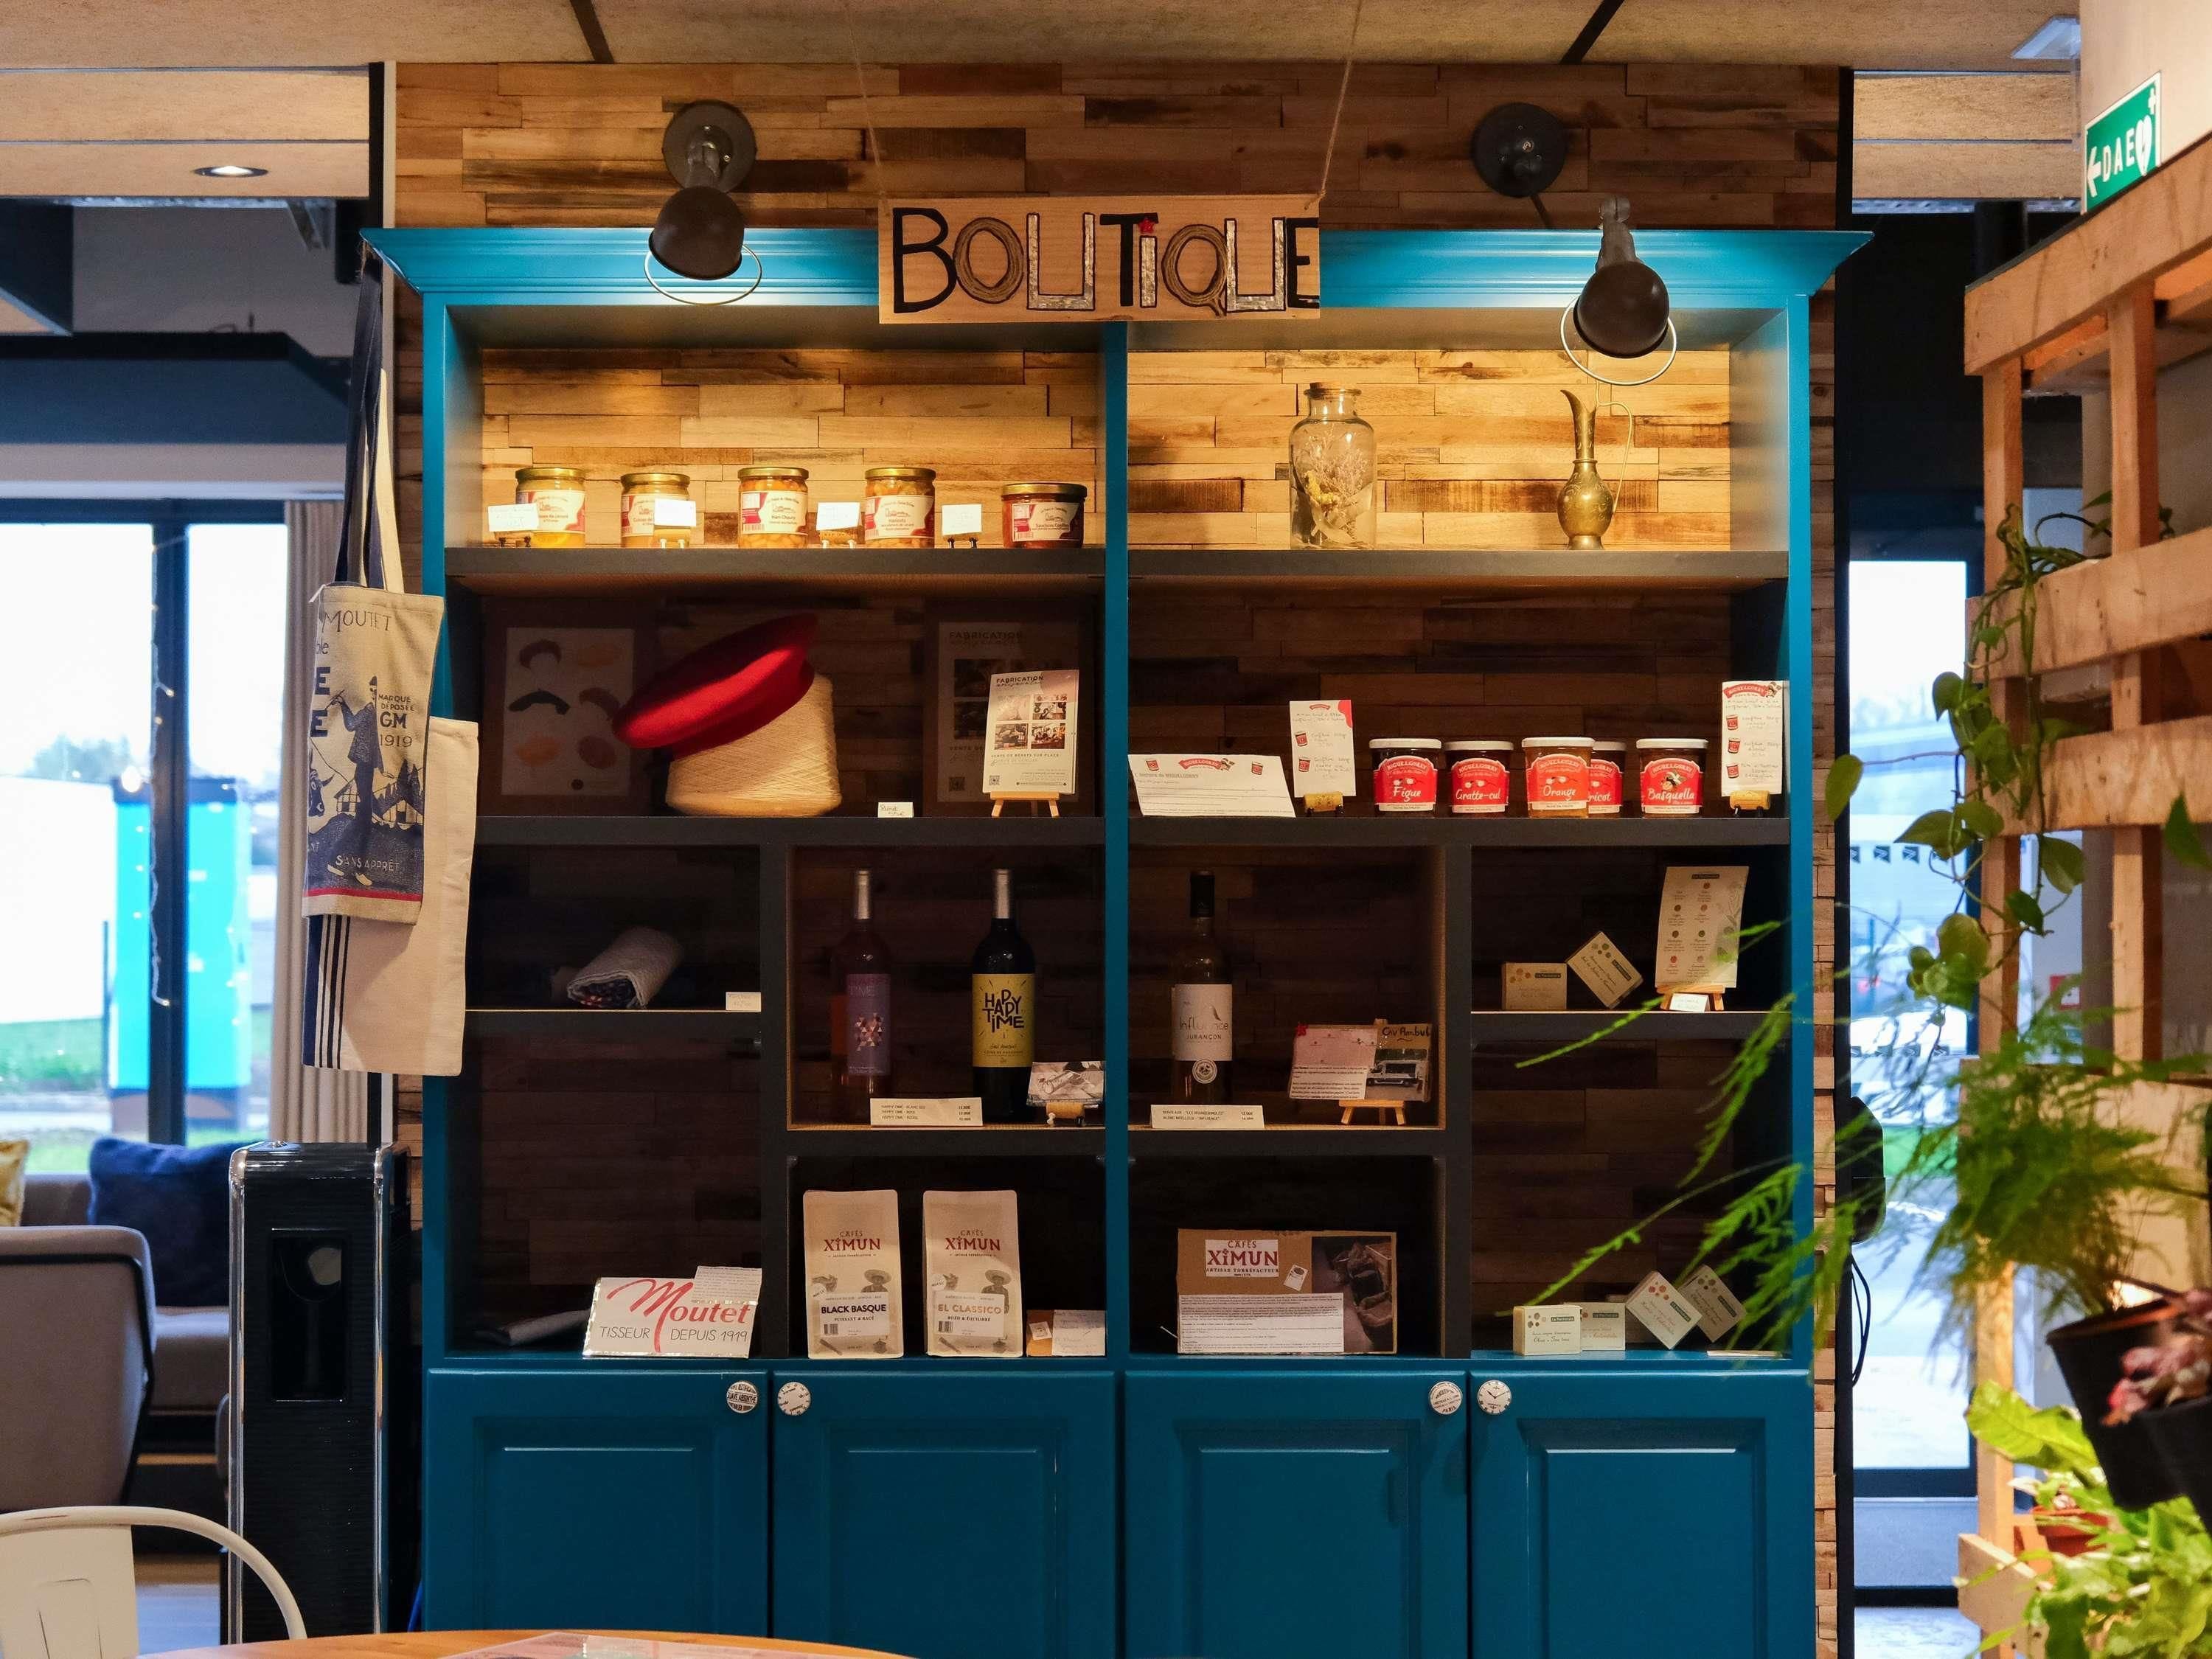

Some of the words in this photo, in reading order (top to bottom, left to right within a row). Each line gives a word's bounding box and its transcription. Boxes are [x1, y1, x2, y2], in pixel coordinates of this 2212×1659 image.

[2102, 128, 2136, 182] DAE
[321, 609, 392, 633] MOUTET
[996, 675, 1044, 684] FABRICATION
[378, 694, 411, 703] MARQUE
[380, 711, 408, 729] GM
[380, 734, 412, 748] 1919
[1393, 786, 1422, 802] Figue
[1455, 788, 1502, 800] Gratte-cul
[1543, 785, 1576, 801] Orange
[1588, 791, 1612, 802] ricot
[1647, 787, 1695, 804] Basquella
[335, 855, 361, 869] SANS
[984, 989, 1022, 1018] HAPPY
[606, 1278, 752, 1353] Moutet
[821, 1305, 849, 1314] BLACK
[851, 1304, 887, 1313] BASQUE
[937, 1304, 949, 1312] EL
[952, 1304, 1002, 1314] CLASSICO
[599, 1326, 651, 1340] TISSEUR
[669, 1328, 717, 1341] DEPUIS
[720, 1330, 748, 1343] 1919
